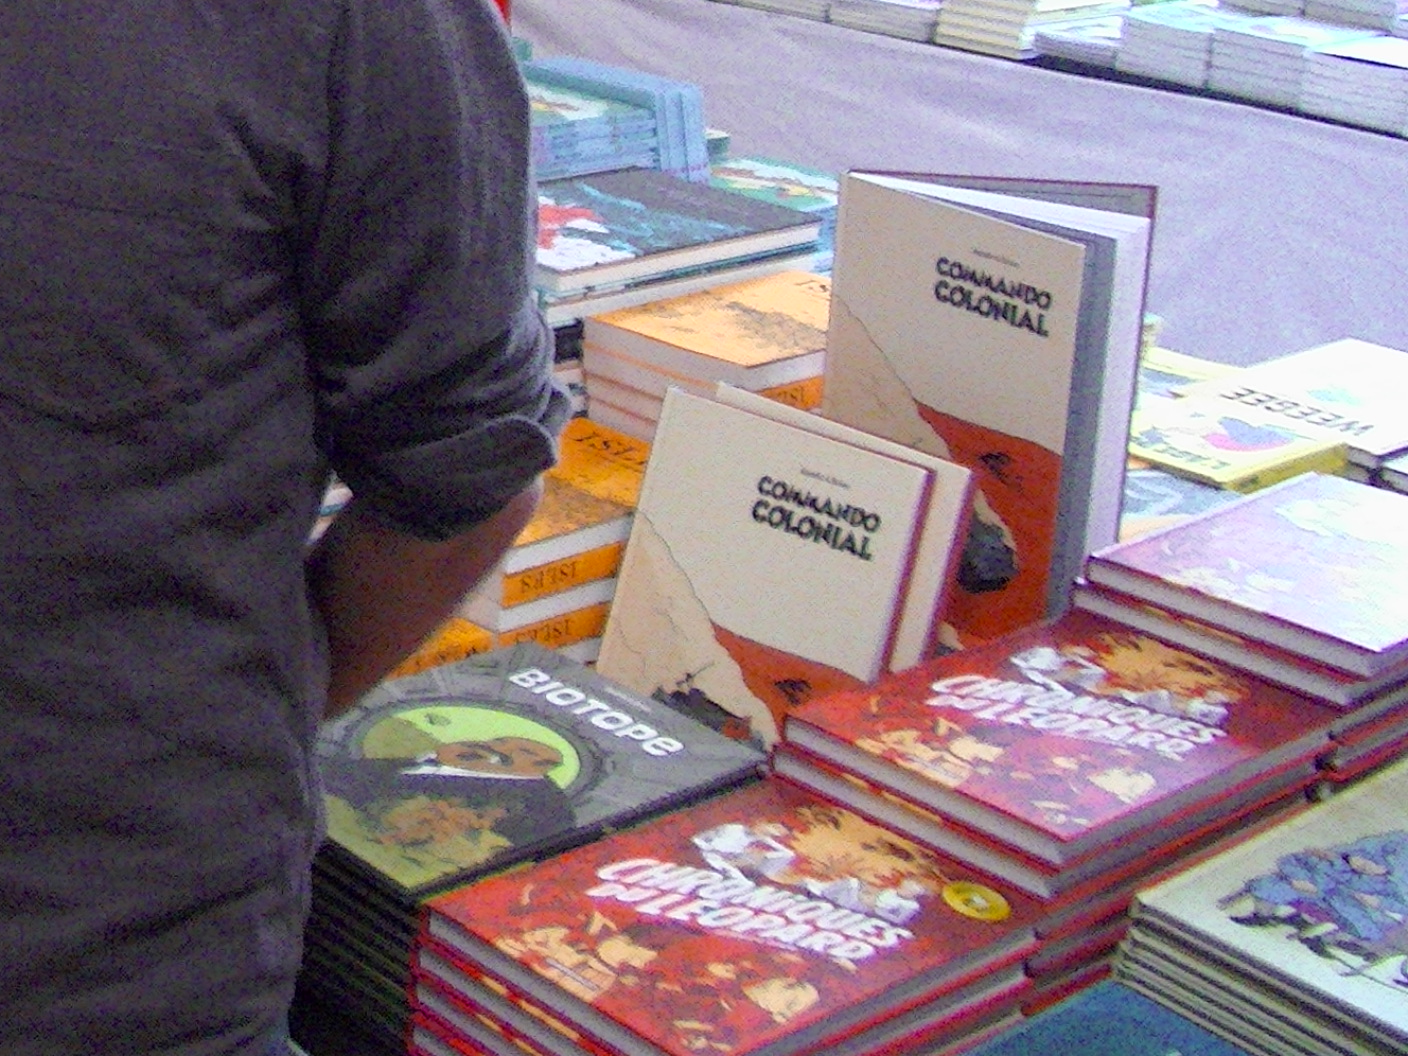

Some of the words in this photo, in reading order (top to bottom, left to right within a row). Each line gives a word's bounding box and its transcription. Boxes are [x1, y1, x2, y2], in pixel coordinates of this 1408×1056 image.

[934, 280, 1049, 337] COLONIAL
[936, 257, 1052, 311] COMMANDO
[751, 499, 873, 562] COLONIAL
[757, 475, 882, 534] COMMANDO
[597, 858, 913, 947] CHRONIQUES
